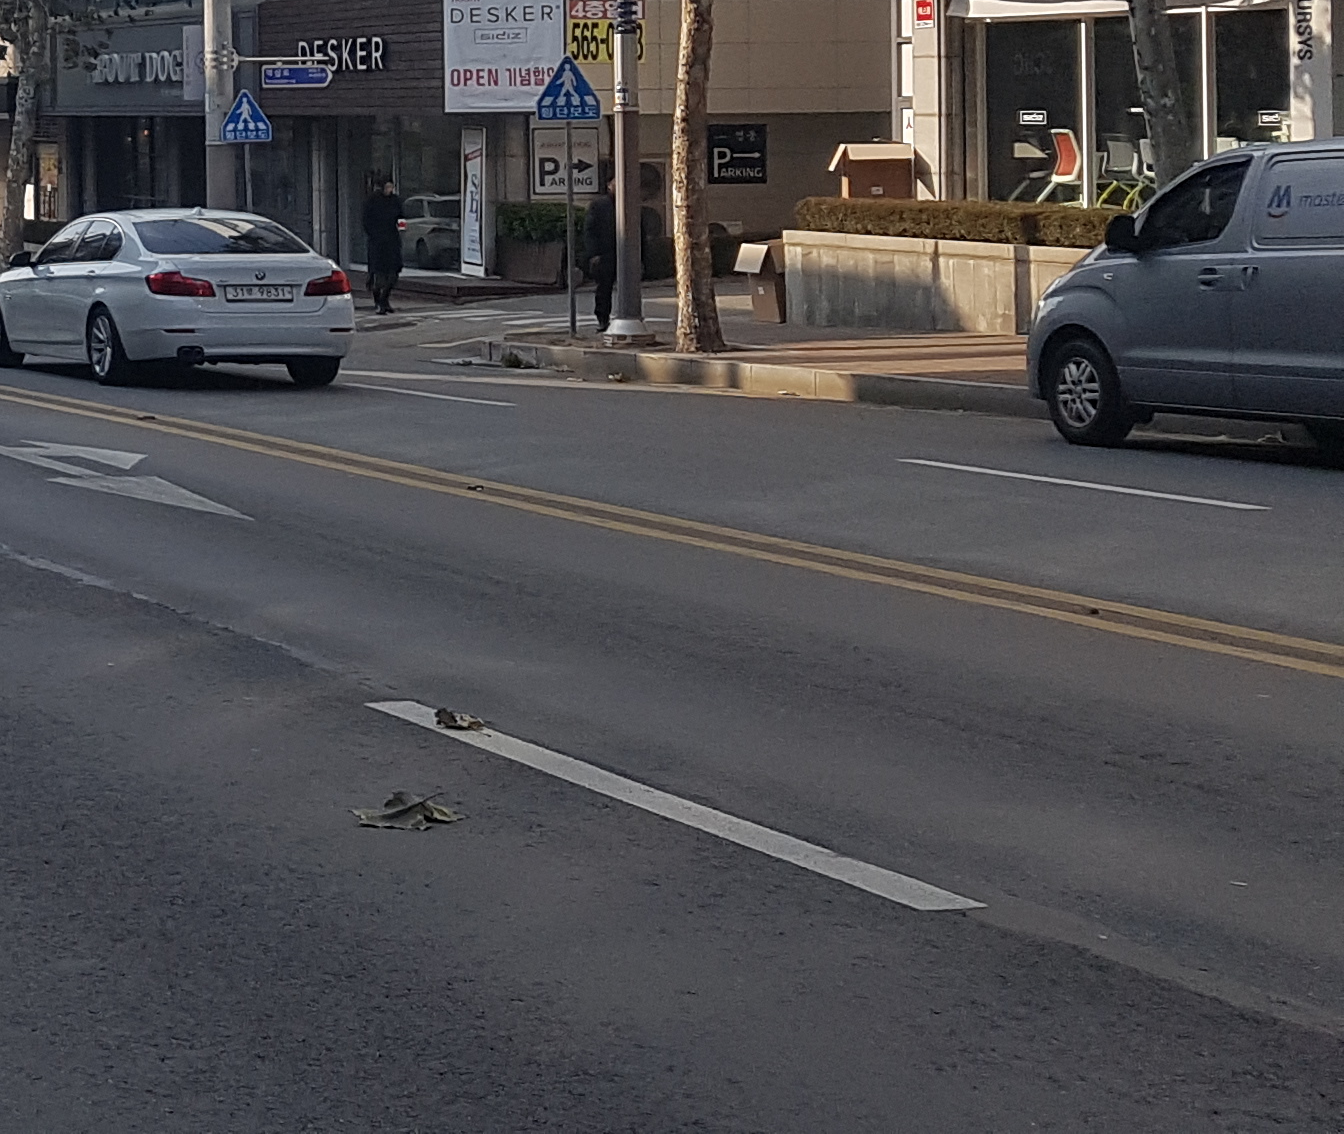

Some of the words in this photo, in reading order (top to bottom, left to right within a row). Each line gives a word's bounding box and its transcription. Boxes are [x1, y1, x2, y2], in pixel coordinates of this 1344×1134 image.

[450, 5, 553, 24] DESKER
[298, 37, 383, 71] DESKER
[571, 22, 644, 60] 565-03
[144, 49, 183, 82] DOG
[450, 68, 500, 87] OPEN
[539, 157, 593, 187] PARING
